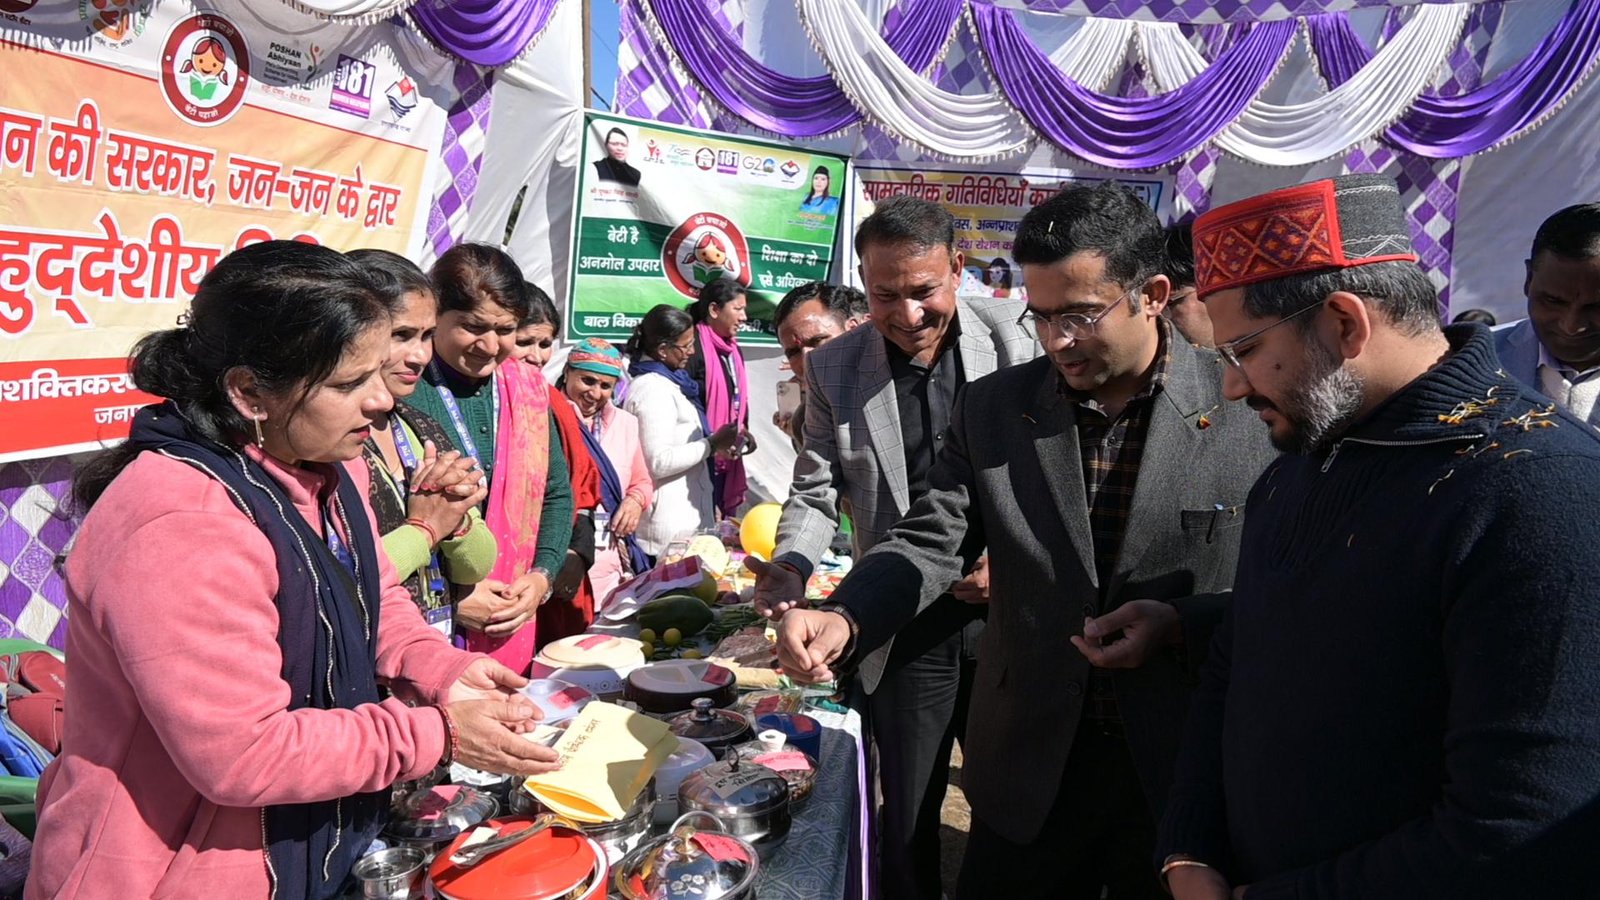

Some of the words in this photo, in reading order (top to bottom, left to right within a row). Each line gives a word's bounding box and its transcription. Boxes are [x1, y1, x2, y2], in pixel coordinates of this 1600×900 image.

[267, 51, 302, 68] Abhiyaan
[269, 42, 302, 59] POSHAN
[338, 58, 376, 98] 181
[0, 110, 43, 174] न
[49, 102, 101, 182] की
[106, 132, 215, 202] सरकार,
[228, 157, 336, 216] जन-जन
[336, 165, 364, 219] के
[364, 184, 401, 228] द्वार
[719, 151, 739, 167] 181
[945, 175, 1028, 208] गतिविधियाँ
[607, 225, 628, 244] बेटी
[630, 225, 640, 245] है
[976, 218, 1019, 233] अन्नप्राश
[957, 238, 972, 250] देश
[1002, 240, 1015, 251] क
[579, 252, 625, 271] अनमोल
[627, 257, 661, 272] उपहार
[761, 244, 788, 262] शिक्षा
[789, 252, 805, 265] का
[806, 249, 819, 266] दो
[0, 213, 221, 334] हुद्देशीय
[775, 272, 814, 289] अधिक
[583, 315, 610, 328] बाल
[612, 313, 643, 328] विका
[0, 368, 138, 401] शक्तिकर
[94, 404, 143, 425] जन
